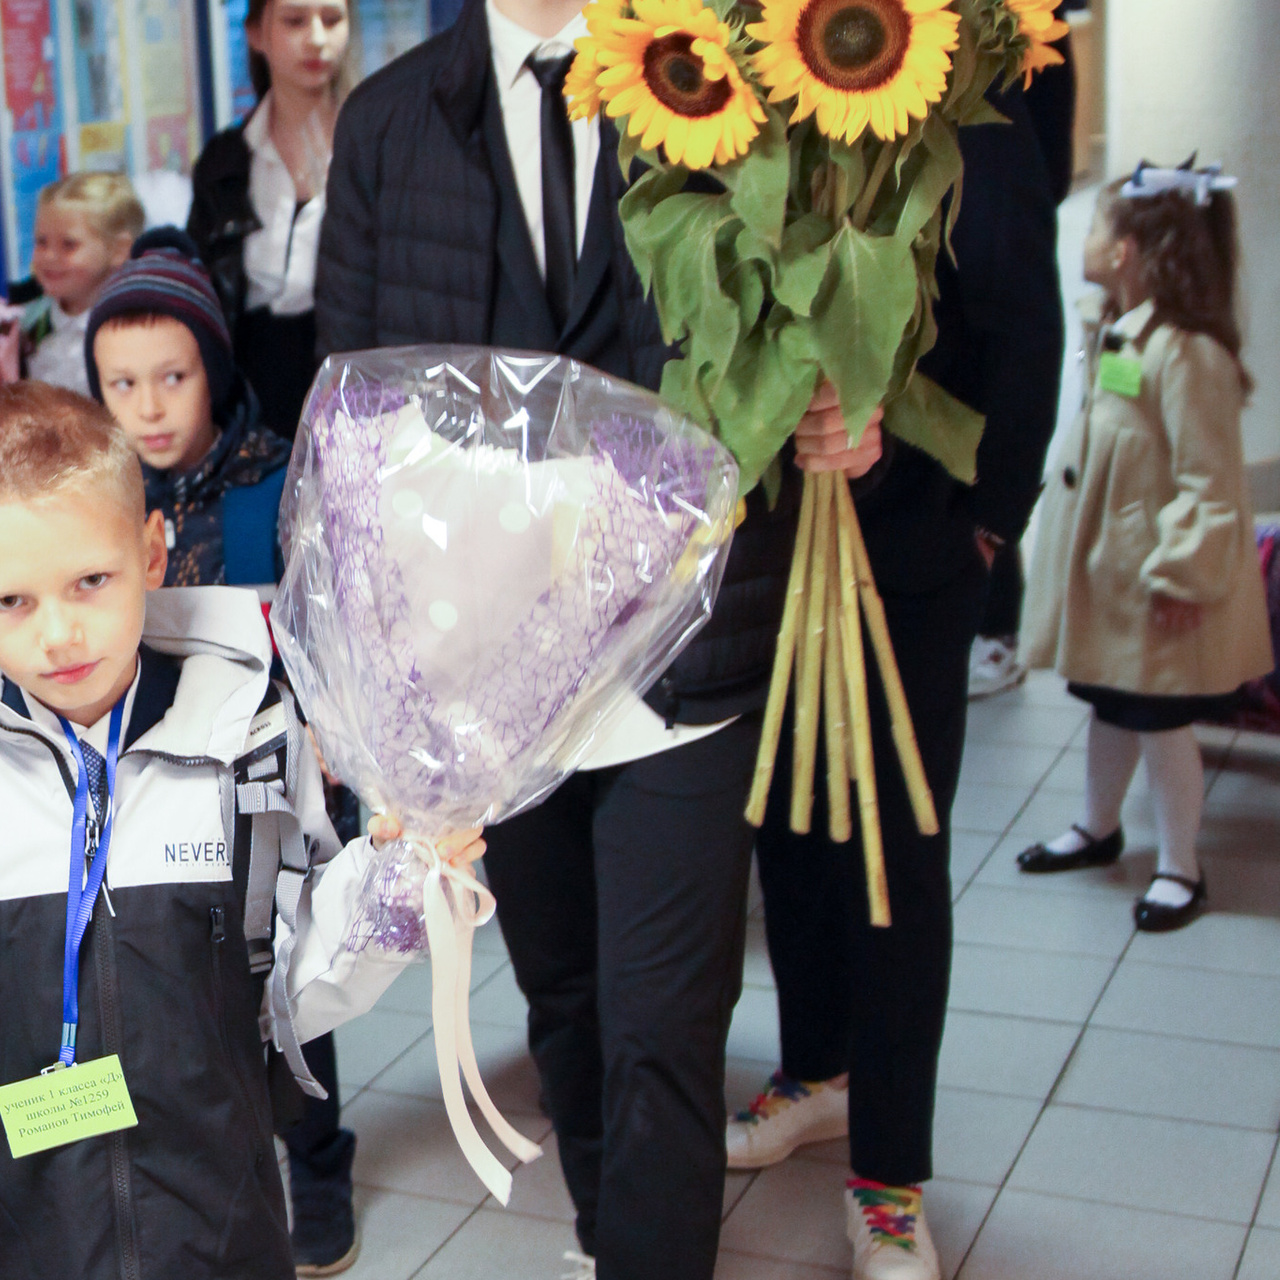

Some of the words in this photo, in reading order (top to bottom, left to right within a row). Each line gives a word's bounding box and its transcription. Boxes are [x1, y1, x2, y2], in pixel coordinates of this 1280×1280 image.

[165, 842, 226, 862] NEVER
[4, 1095, 46, 1114] ученик
[49, 1090, 54, 1099] 1
[59, 1080, 97, 1097] класса
[26, 1104, 66, 1121] школы
[70, 1089, 110, 1109] №1259
[18, 1118, 69, 1138] Романов
[71, 1100, 125, 1122] Тимофей
